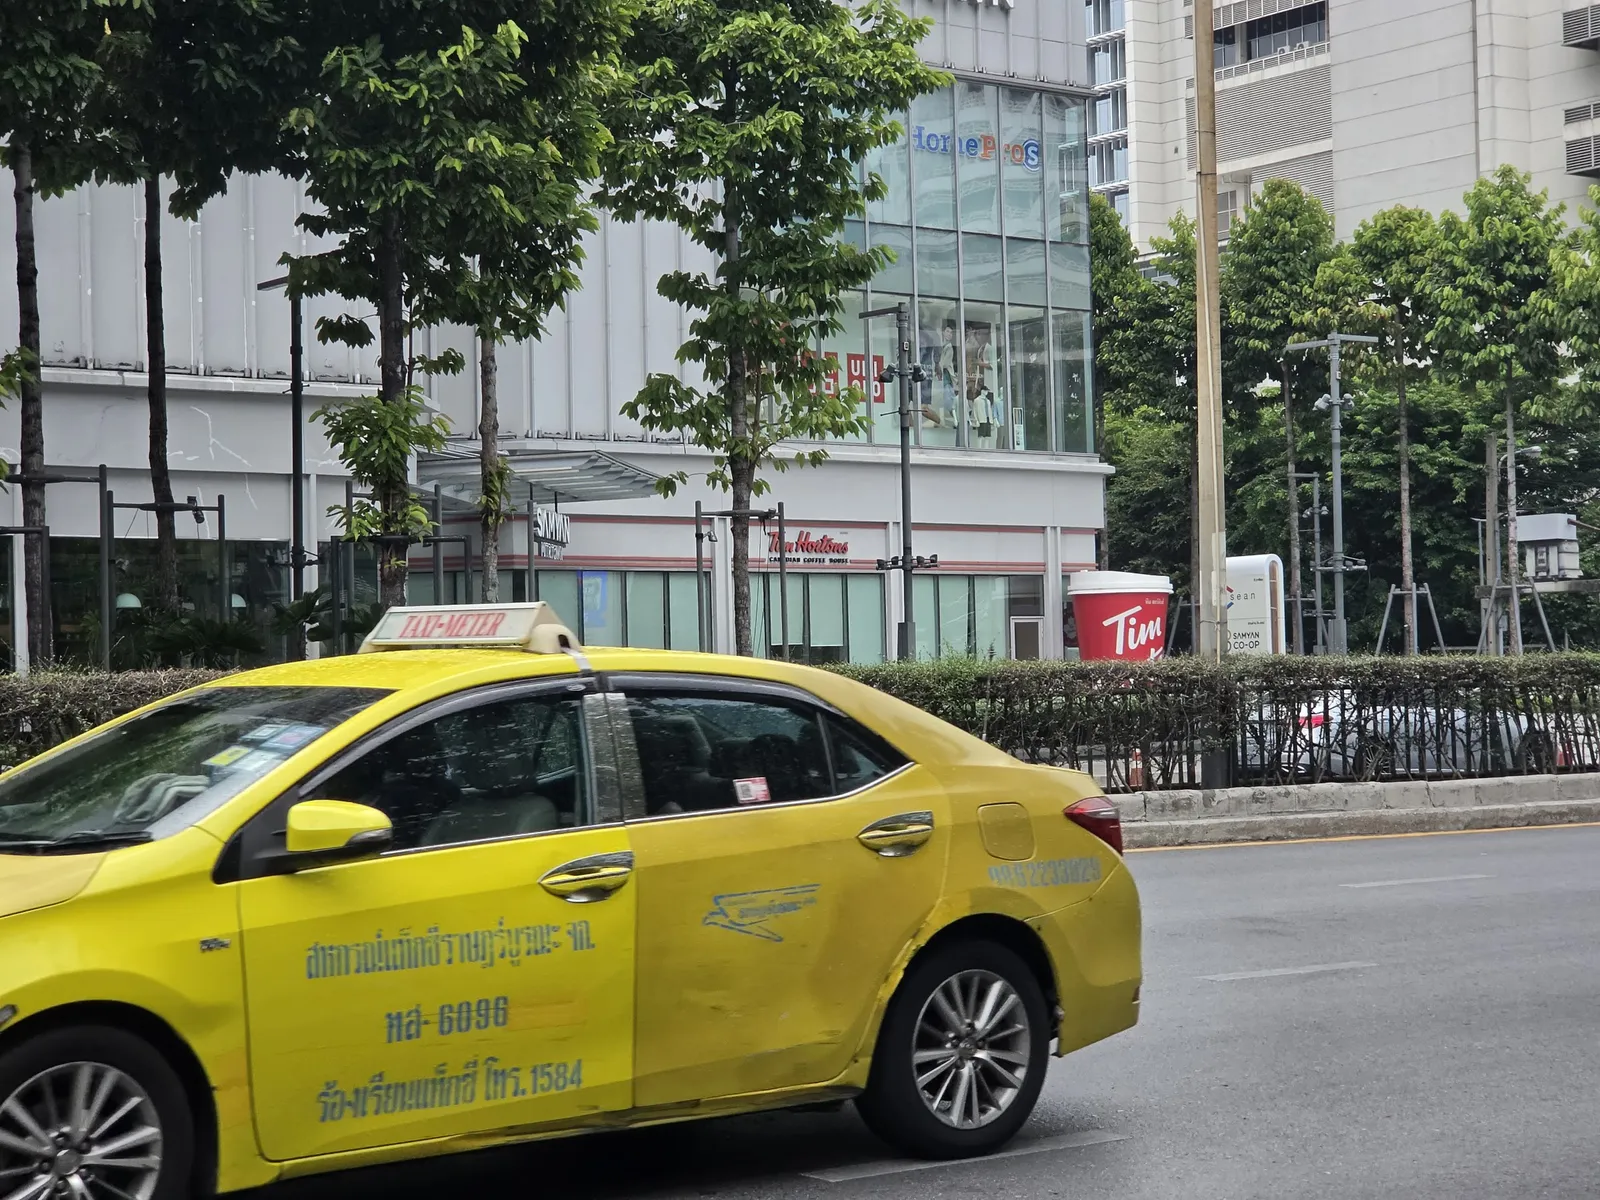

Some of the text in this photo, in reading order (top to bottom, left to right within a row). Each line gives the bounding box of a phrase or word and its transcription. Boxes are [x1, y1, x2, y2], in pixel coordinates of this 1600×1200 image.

[536, 507, 570, 543] SAMYAN
[795, 530, 849, 554] Hortons
[399, 612, 507, 638] TAXI-METER
[1102, 605, 1162, 655] Tim
[1233, 631, 1260, 640] SAMYAN
[1233, 640, 1260, 650] CO-OP
[438, 996, 509, 1036] 6096
